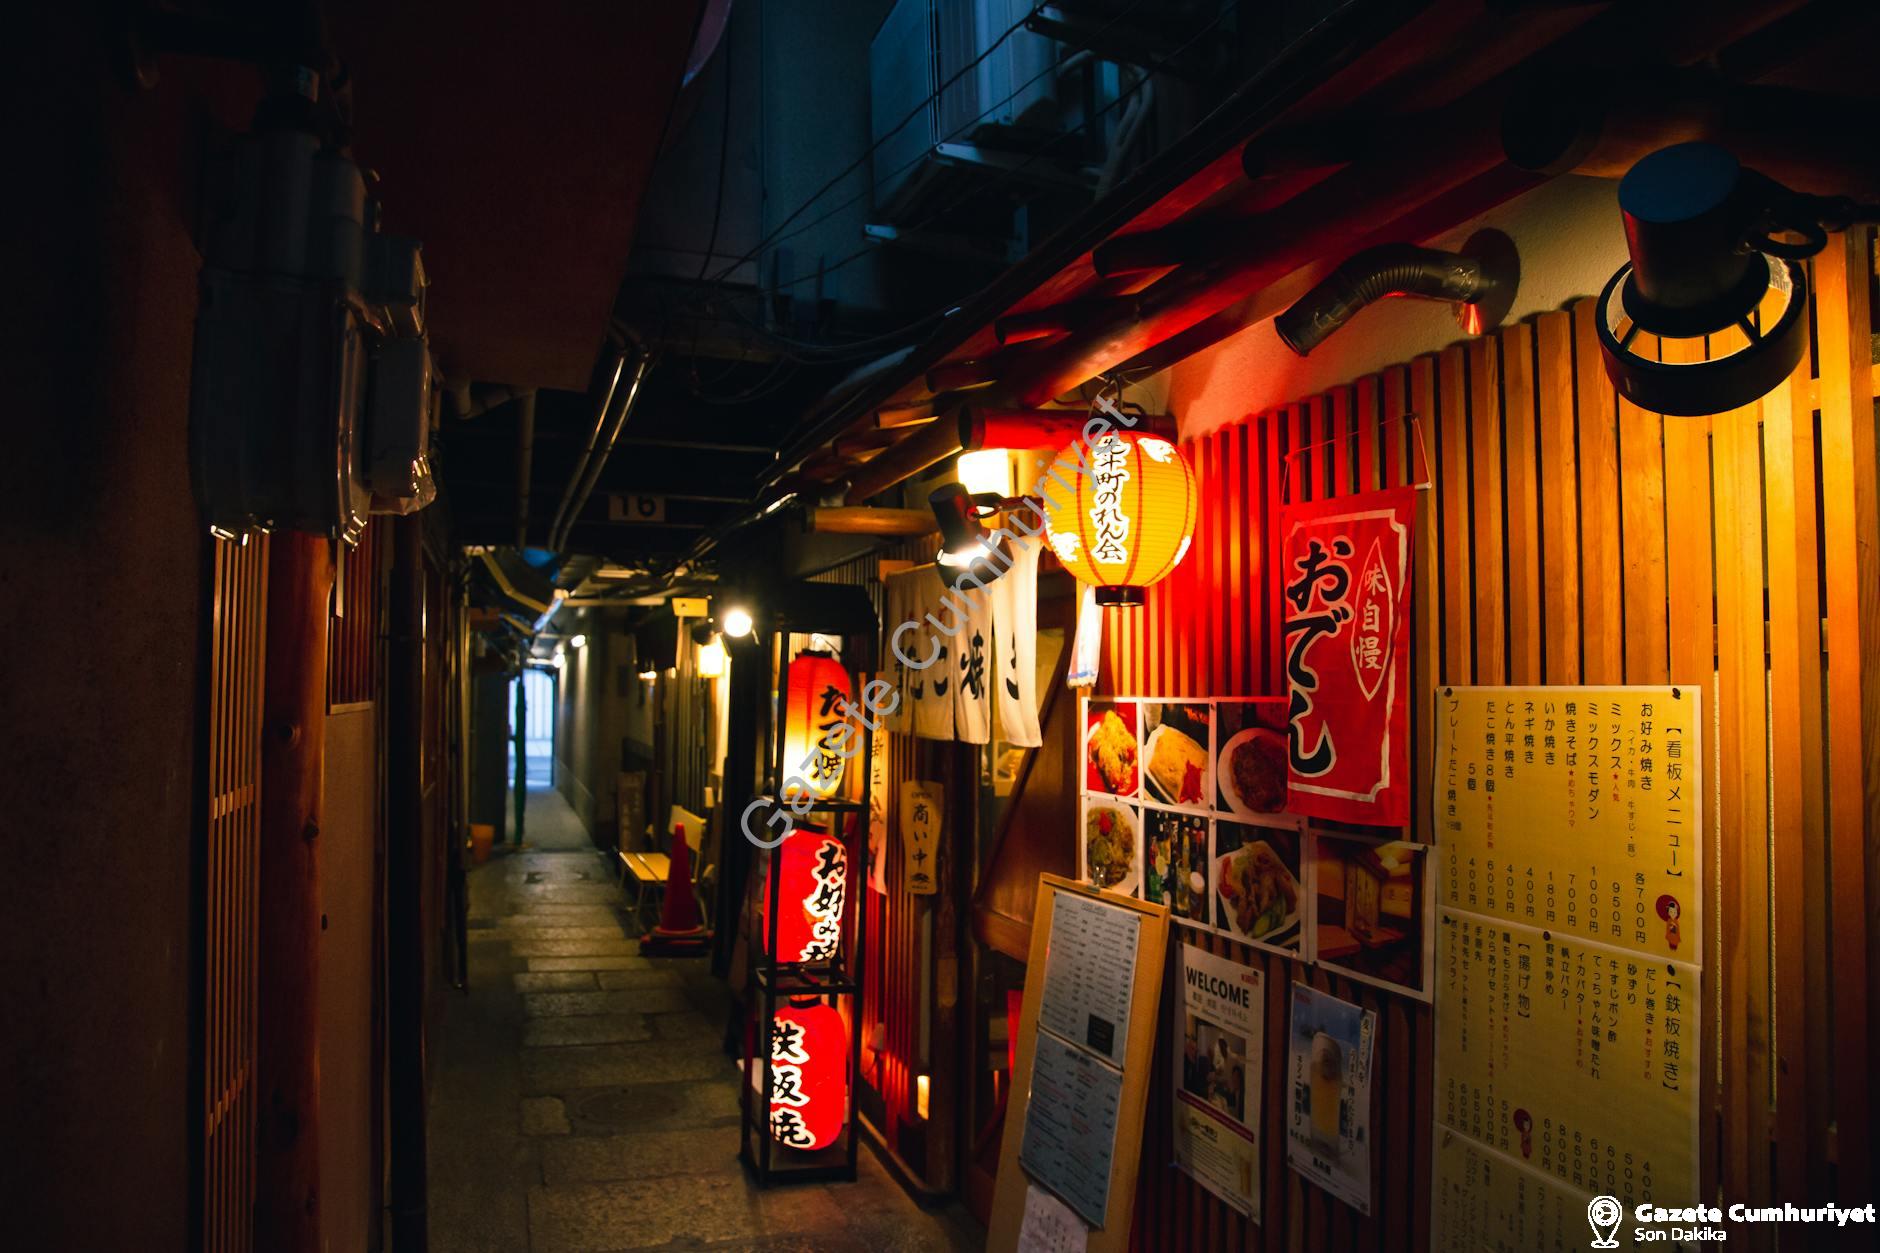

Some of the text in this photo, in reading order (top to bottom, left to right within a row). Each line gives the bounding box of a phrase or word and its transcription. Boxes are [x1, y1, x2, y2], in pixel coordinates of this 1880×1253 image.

[1355, 563, 1387, 671] 味自慢
[1485, 701, 1496, 793] たこ焼き8個
[1565, 702, 1577, 767] 焼きそば
[1610, 702, 1622, 770] ミックス
[912, 802, 930, 868] 商い中
[1504, 701, 1515, 913] とん平焼き 400円
[1524, 702, 1535, 918] ネギ焼き 400円
[1544, 702, 1556, 922] いか焼き 180円
[1588, 702, 1600, 933] ミックスモダン 1000円
[1635, 702, 1653, 944] お好み焼き 各700円
[1666, 727, 1683, 877] 【看板メニュー】
[1468, 858, 1477, 905] 400円
[1487, 860, 1495, 909] 600円
[1567, 873, 1577, 927] 700円
[1611, 882, 1622, 937] 950円
[1186, 966, 1249, 1009] WELCOME
[1517, 943, 1531, 1019] 【揚げ物】
[1544, 943, 1555, 996] 野菜炒め
[1560, 947, 1571, 1010] 帆立バター
[1575, 952, 1587, 1015] イカバター
[1607, 960, 1619, 1044] 牛すじポン酢
[1626, 963, 1637, 1006] 砂ずり
[1645, 967, 1657, 1025] だし巻き
[1591, 955, 1602, 1080] てっちゃん味噌たれ
[1662, 983, 1682, 1092] 【鉄板焼き】
